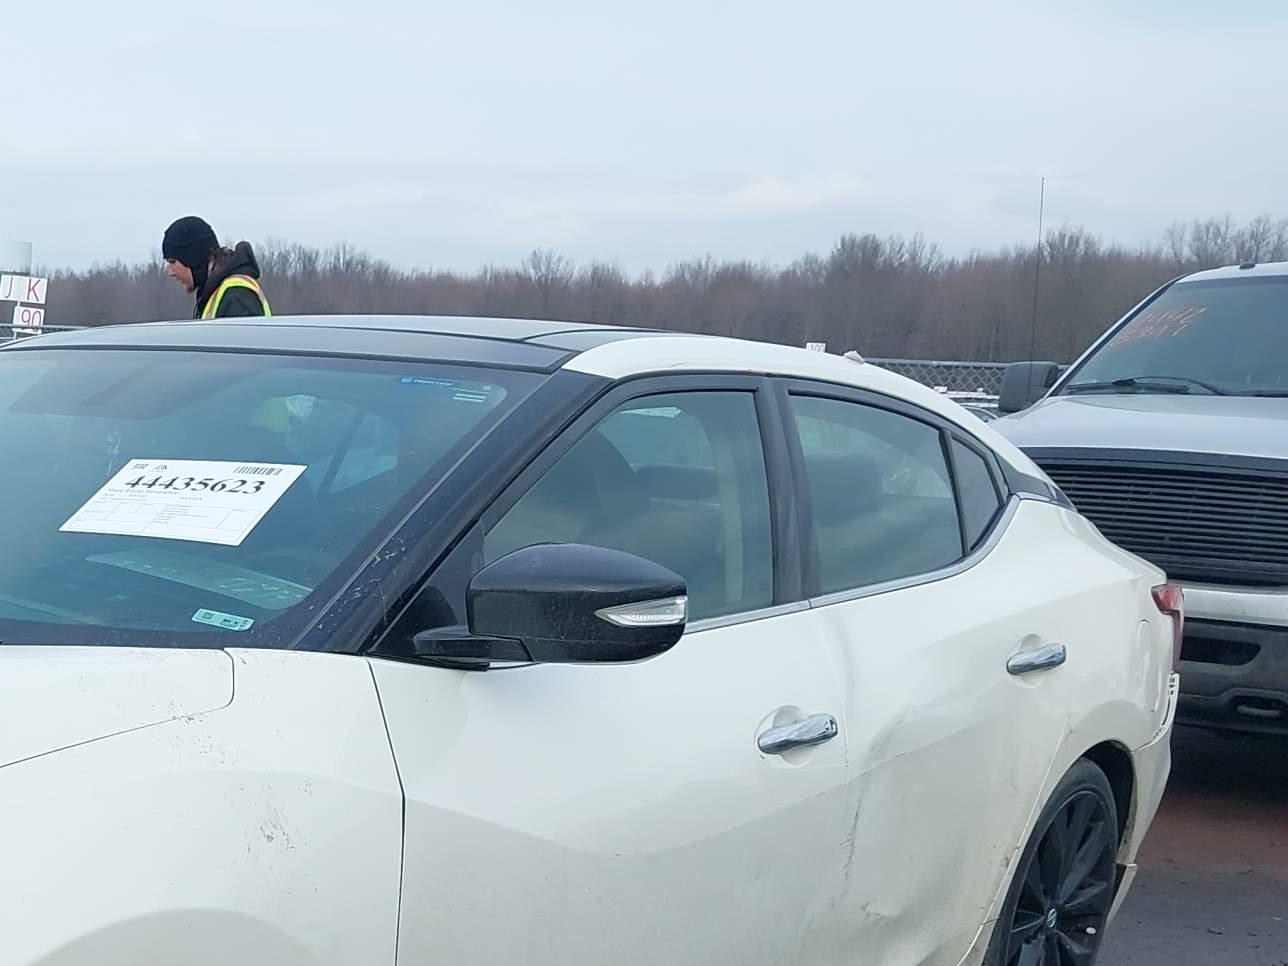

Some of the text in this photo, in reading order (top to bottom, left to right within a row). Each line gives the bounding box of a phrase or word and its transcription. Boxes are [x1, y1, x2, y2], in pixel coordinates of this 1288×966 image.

[4, 276, 41, 302] J K
[21, 309, 42, 332] 90
[124, 474, 266, 495] 44435623
